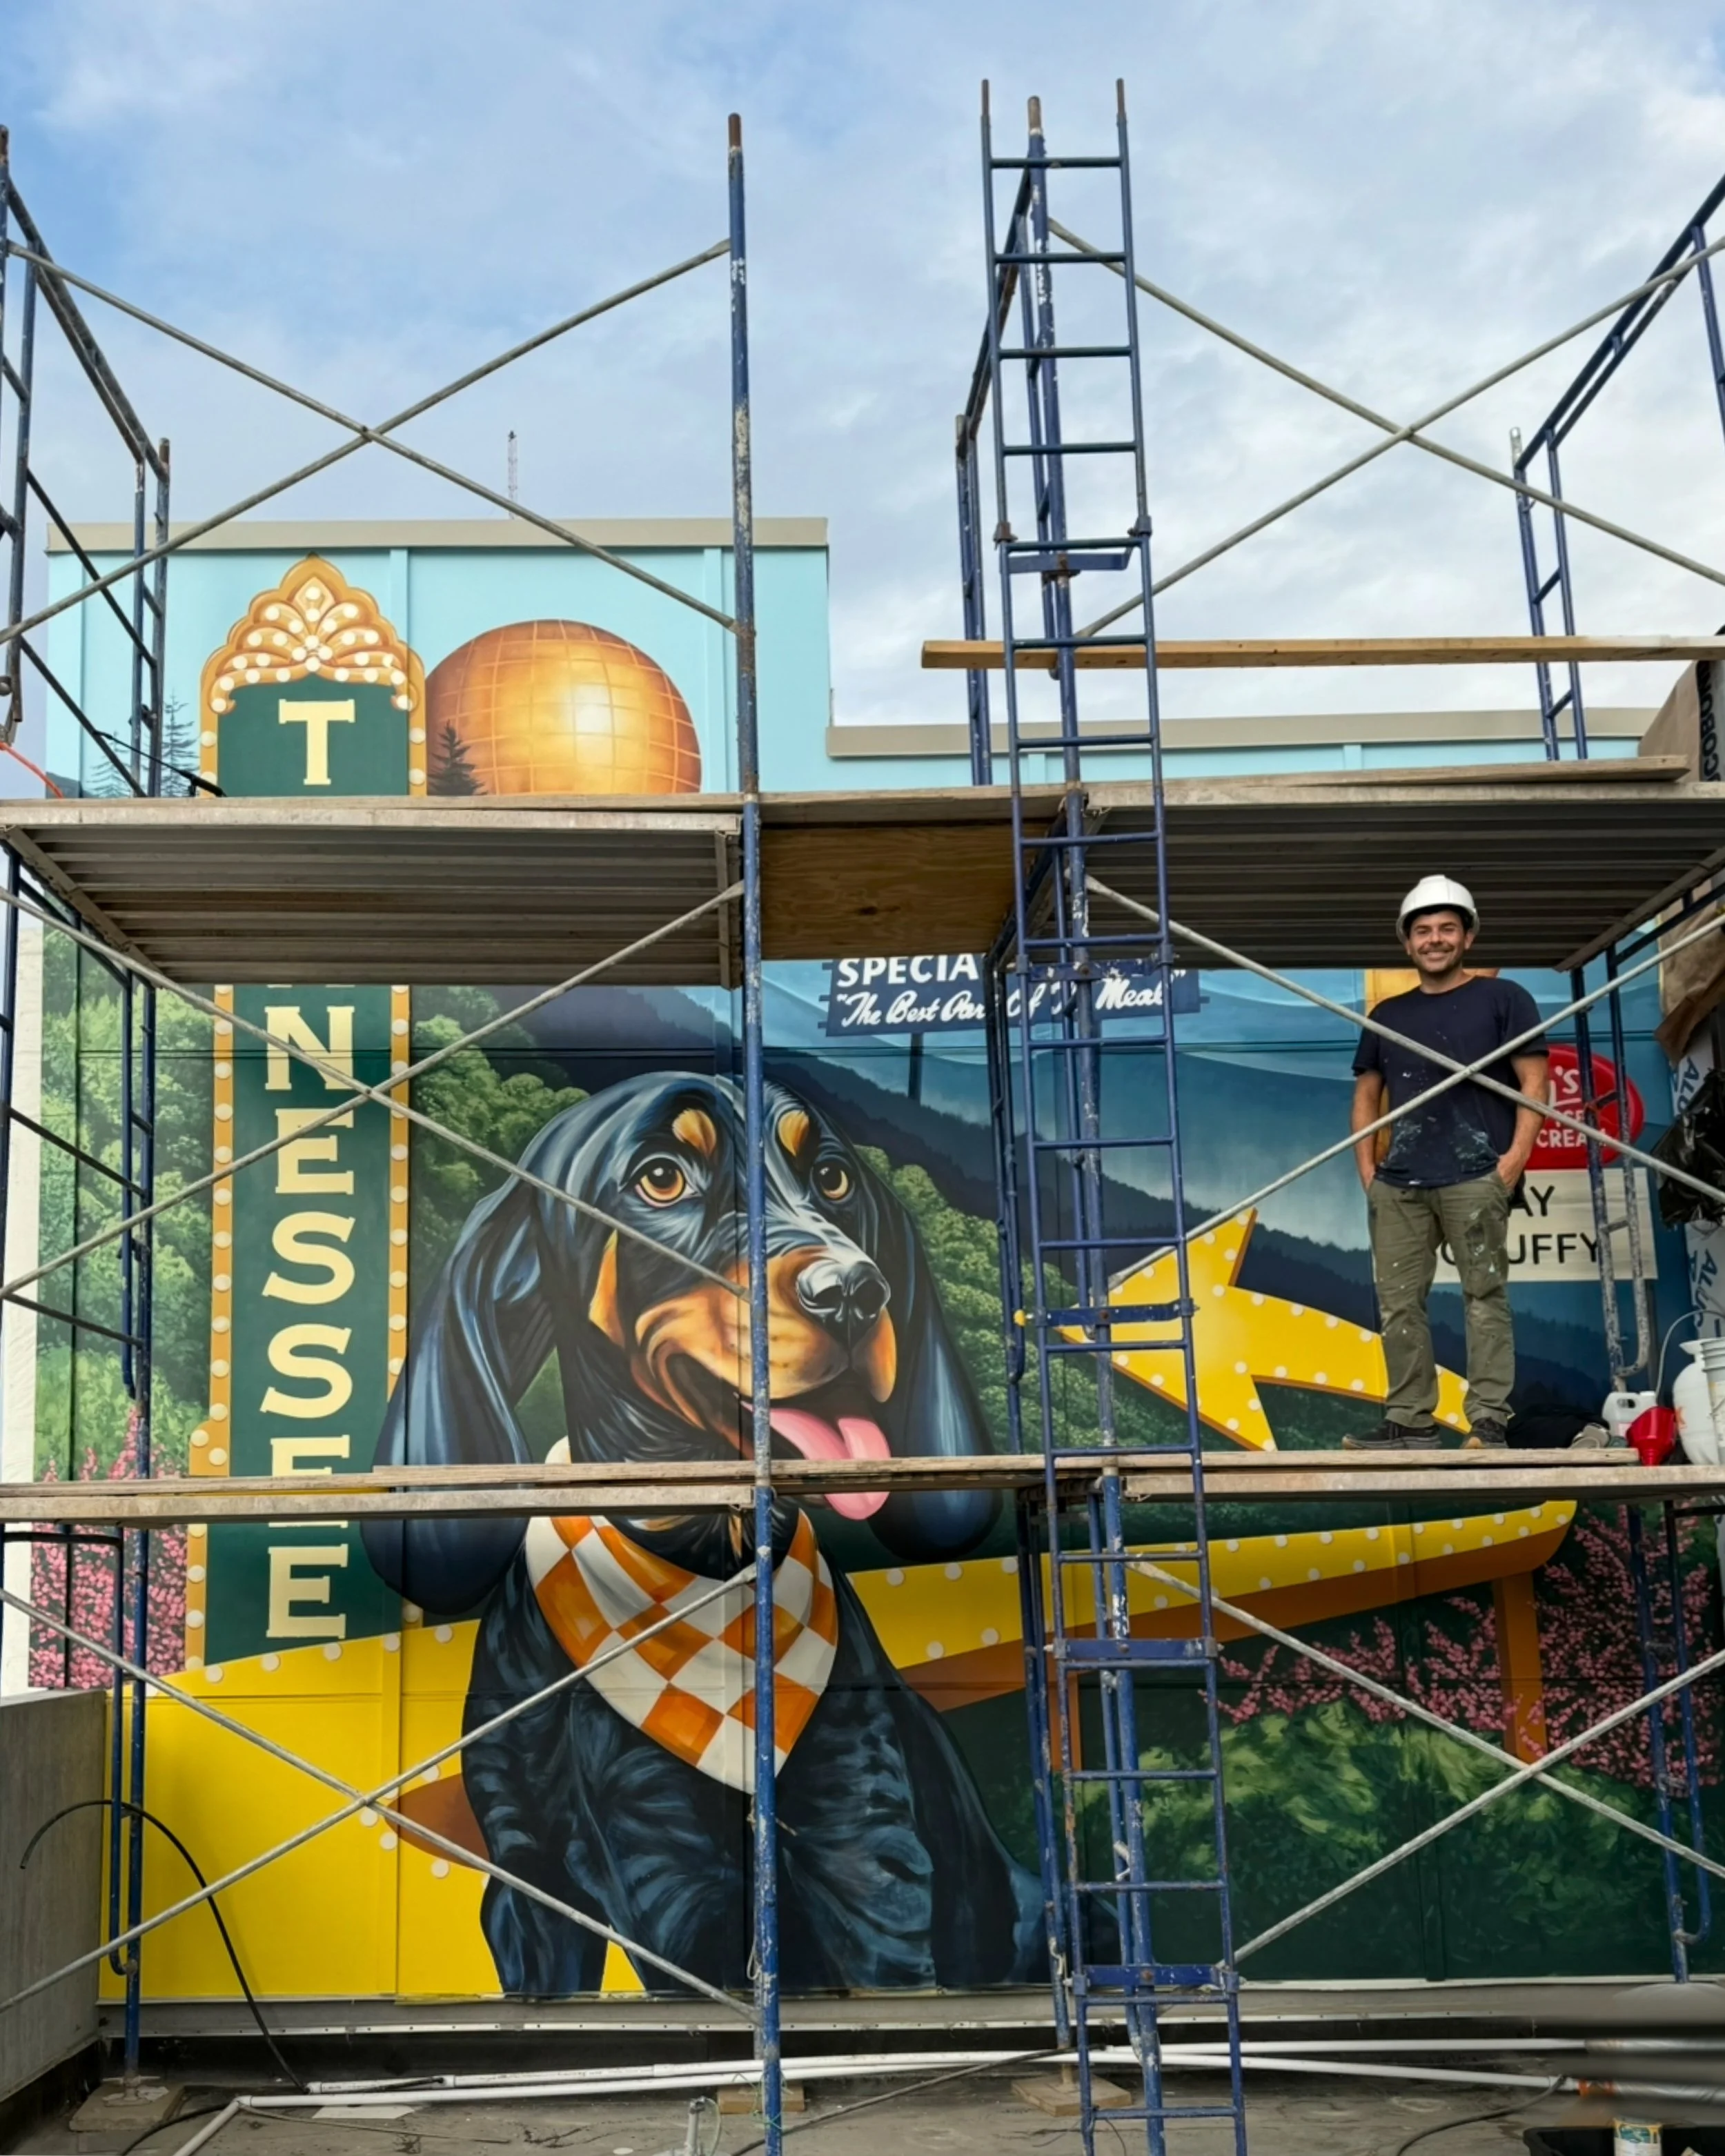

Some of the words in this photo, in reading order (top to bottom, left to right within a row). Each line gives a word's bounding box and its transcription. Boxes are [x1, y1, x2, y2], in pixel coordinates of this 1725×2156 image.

[836, 953, 987, 987] SPECIA
[885, 989, 940, 1024] Best
[940, 989, 987, 1022] Par
